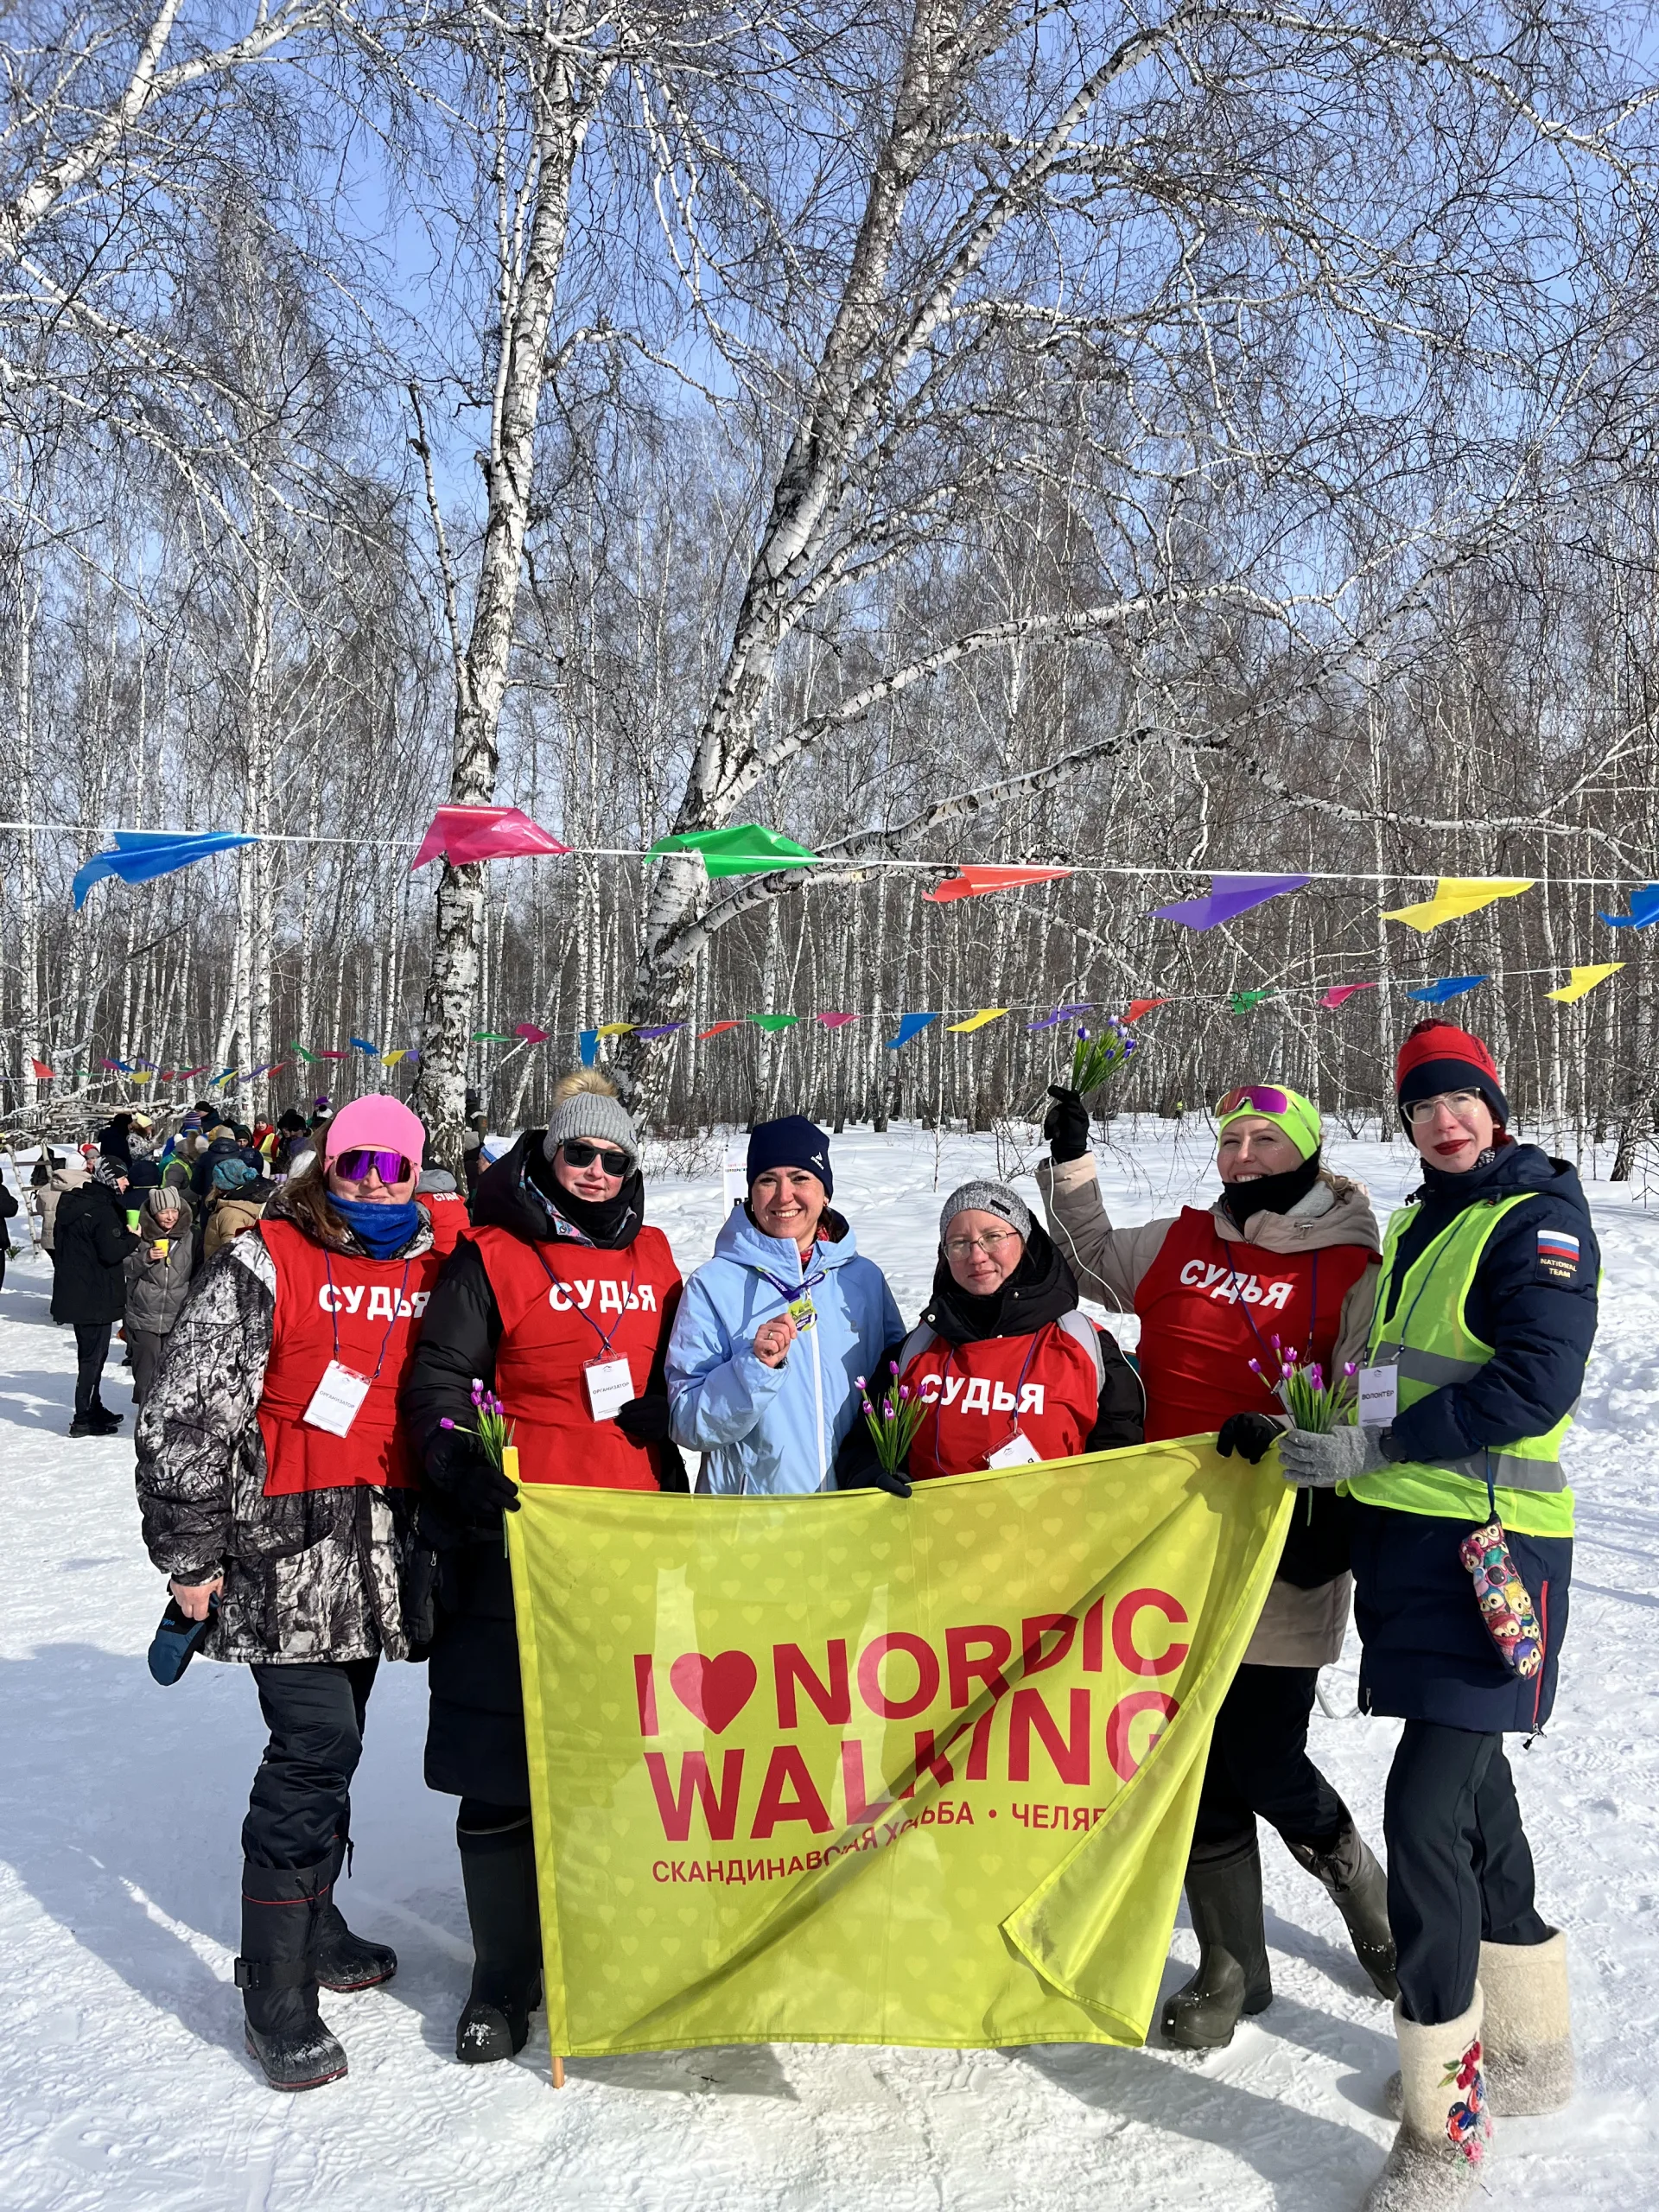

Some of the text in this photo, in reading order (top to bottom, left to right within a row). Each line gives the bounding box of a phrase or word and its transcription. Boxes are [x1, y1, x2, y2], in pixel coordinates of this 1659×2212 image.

[1179, 1259, 1294, 1310] СУДЬЯ
[1540, 1258, 1577, 1272] NATIONAL
[1548, 1268, 1571, 1278] TEAM
[318, 1283, 431, 1322] СУДЬЯ
[549, 1279, 657, 1315] СУДЬЯ
[319, 1390, 356, 1409] ОРГАНИЗАТОР
[592, 1382, 630, 1395] ОРГАНИЗАТОР
[920, 1373, 1046, 1415] СУДЬЯ
[633, 1588, 1190, 1737] I NORDIC
[643, 1688, 1180, 1842] WALKING
[652, 1826, 879, 1885] СКАНДИНАВСАЯ
